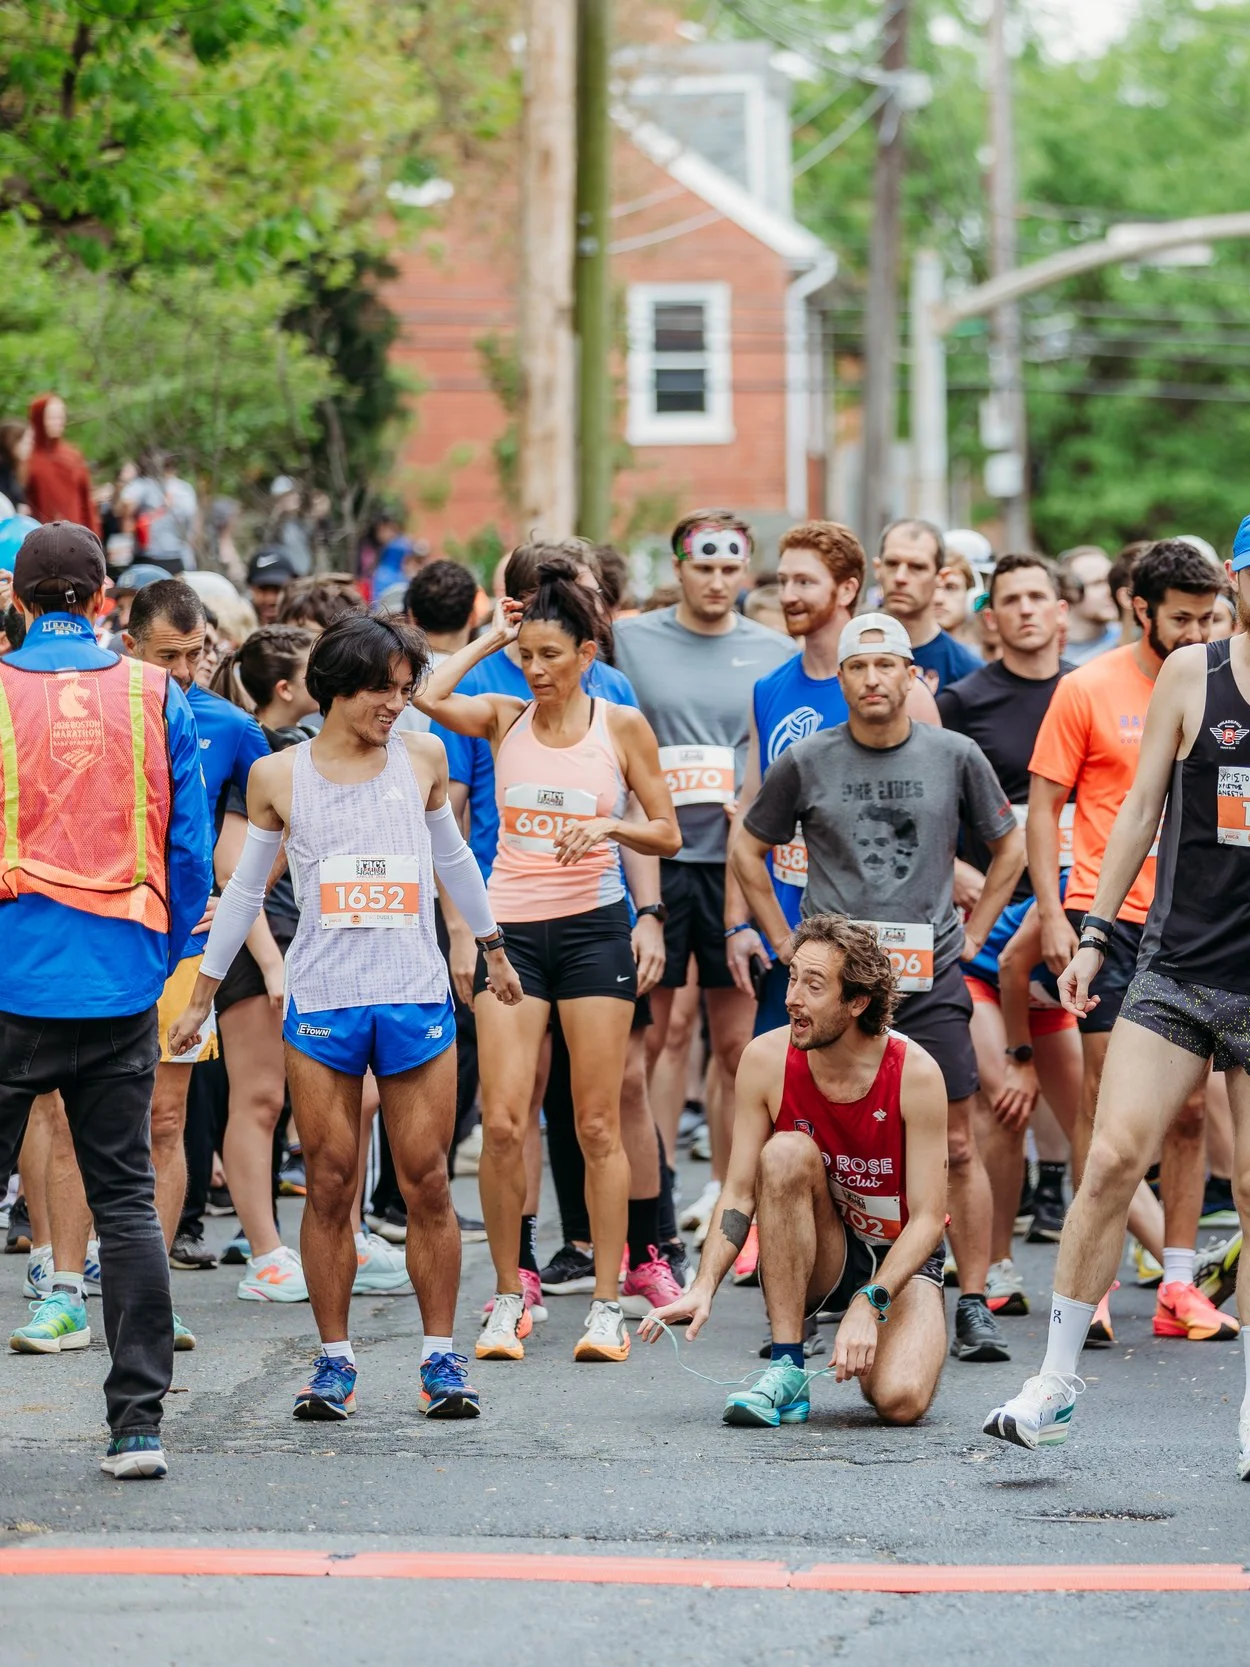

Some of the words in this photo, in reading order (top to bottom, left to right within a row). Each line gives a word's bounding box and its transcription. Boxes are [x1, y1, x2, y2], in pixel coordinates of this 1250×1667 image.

[515, 812, 580, 836] 601
[775, 845, 808, 870] 138
[335, 885, 405, 910] 1652
[836, 1154, 894, 1174] ROSE
[847, 1174, 883, 1188] Club
